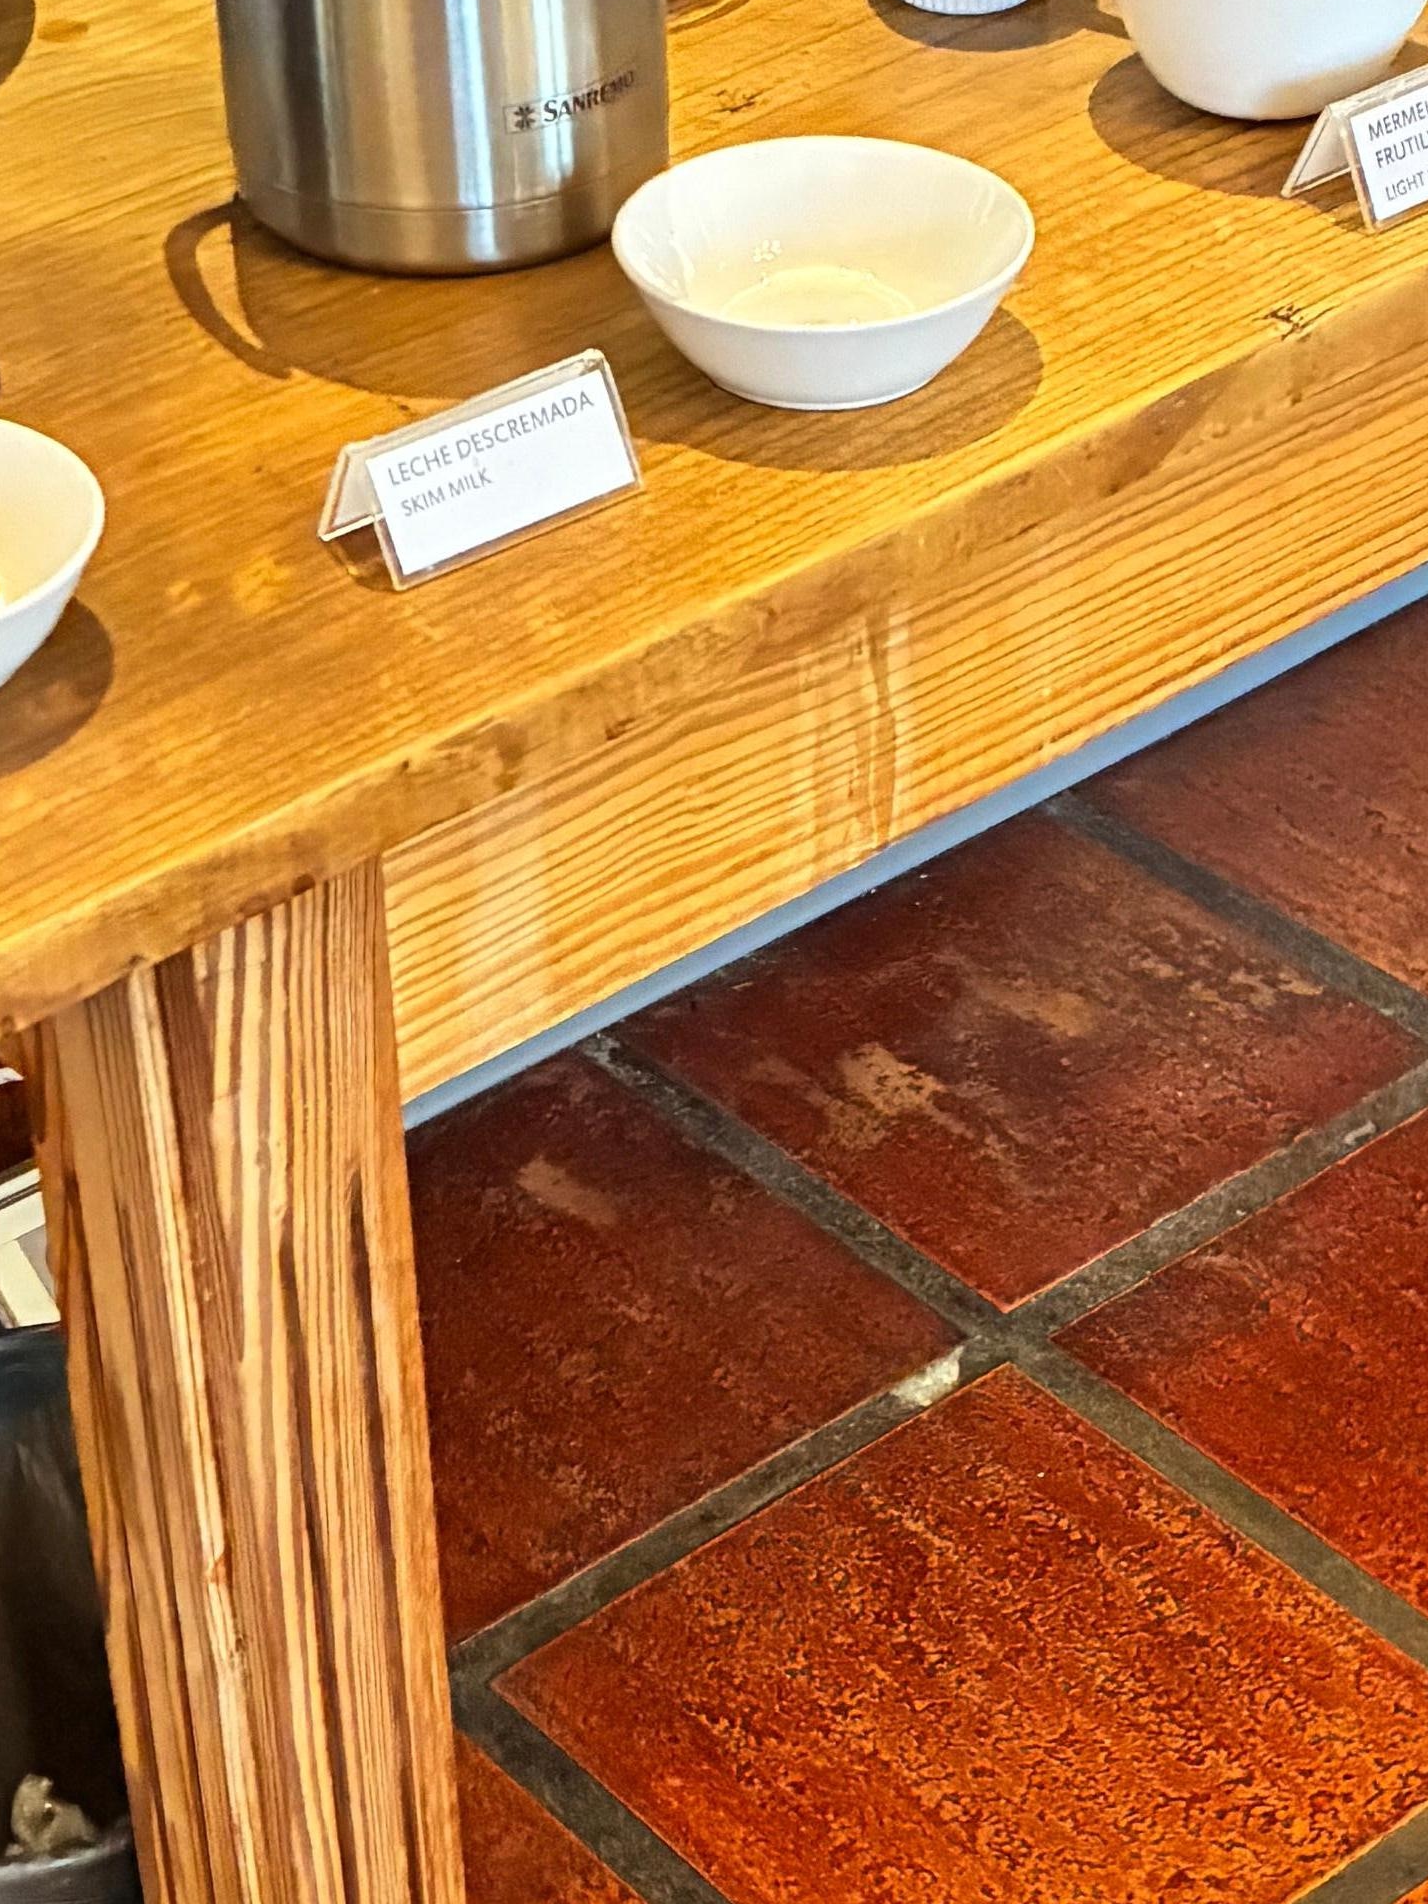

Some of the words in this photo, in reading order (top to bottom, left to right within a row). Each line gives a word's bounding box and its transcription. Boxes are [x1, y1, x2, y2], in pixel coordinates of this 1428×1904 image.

[1385, 172, 1426, 201] LIGHT
[388, 445, 453, 486] LECHE
[455, 390, 595, 460] DESCREMADA
[401, 488, 448, 518] SKIM
[448, 469, 494, 500] MILK
